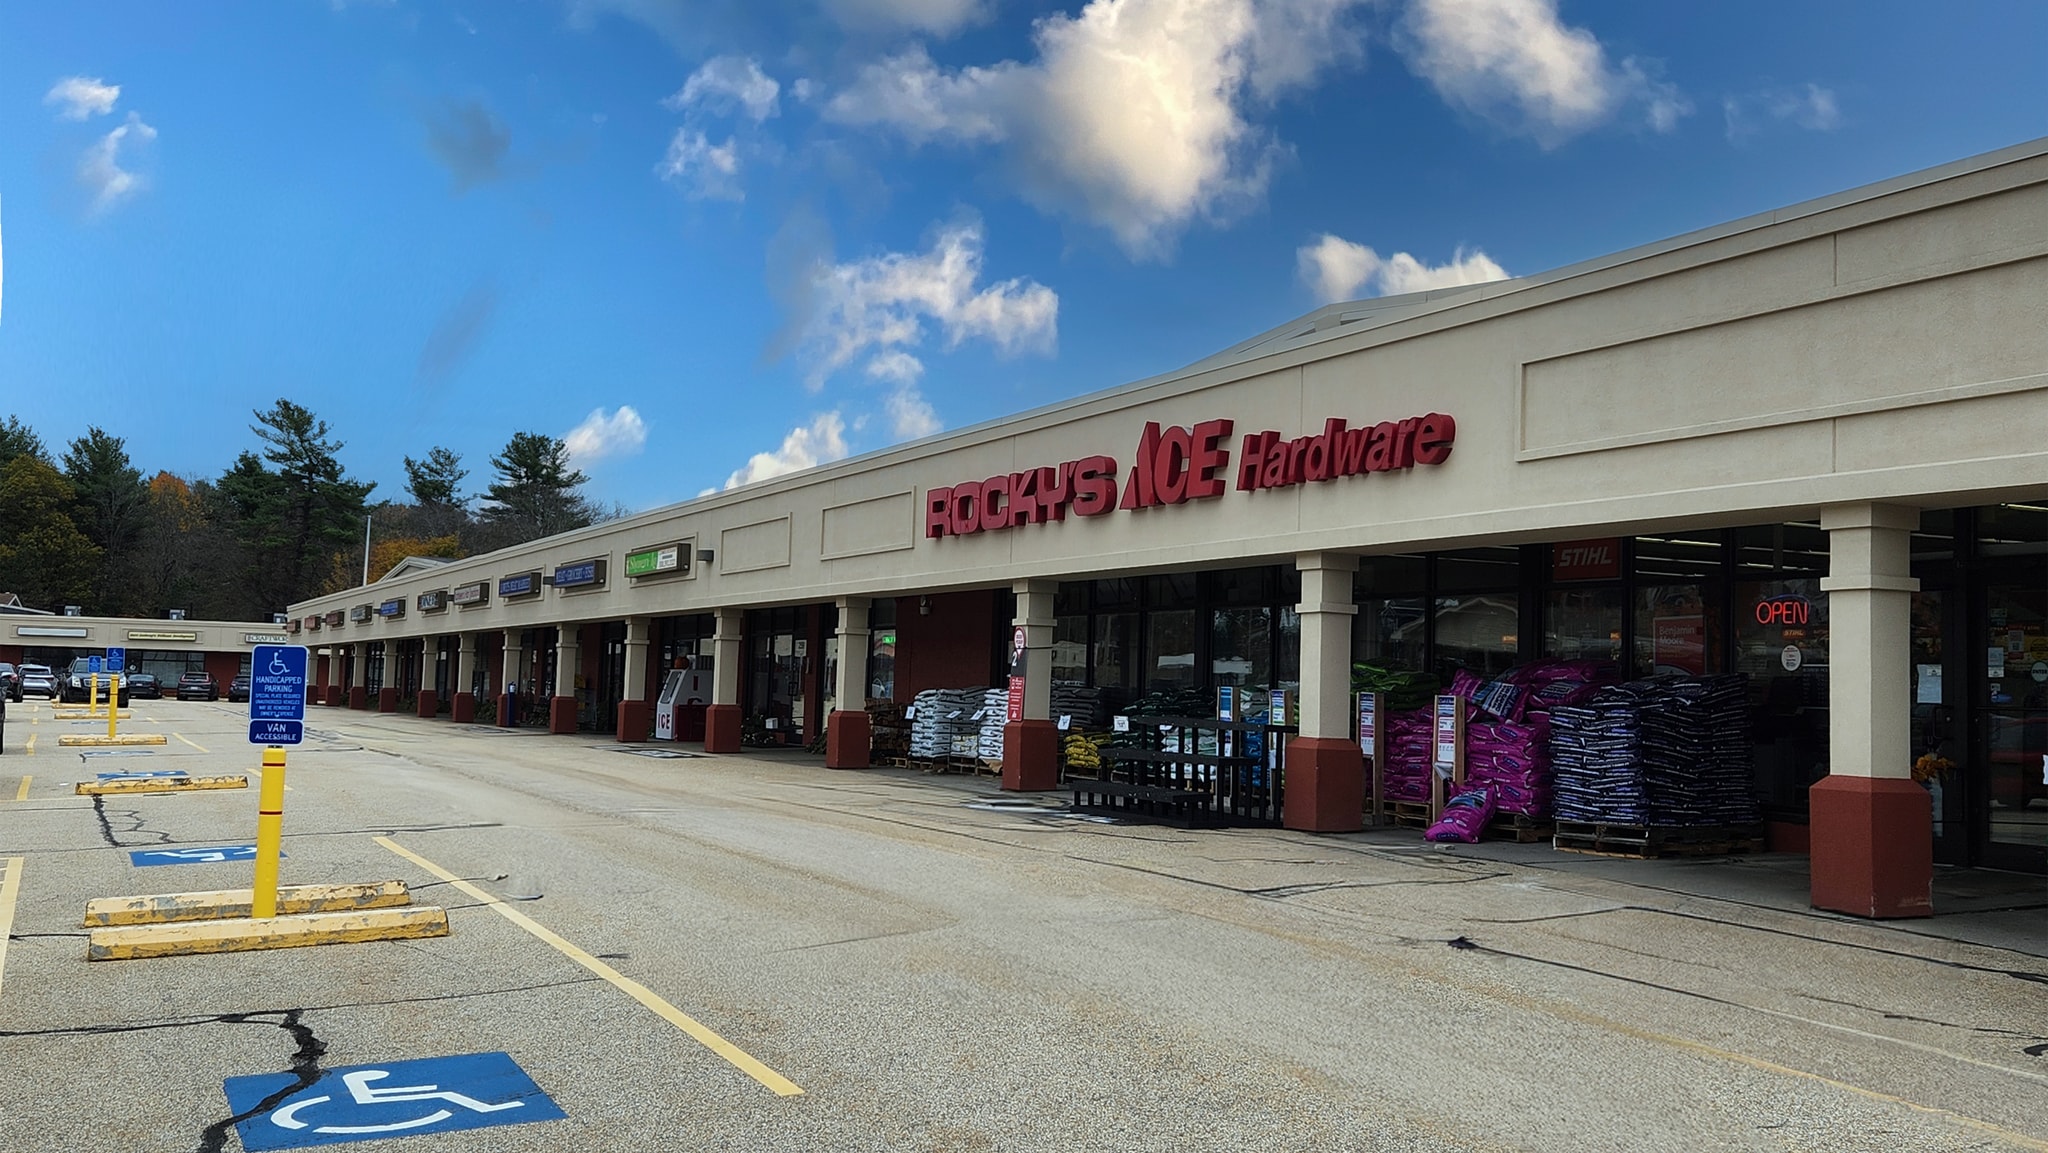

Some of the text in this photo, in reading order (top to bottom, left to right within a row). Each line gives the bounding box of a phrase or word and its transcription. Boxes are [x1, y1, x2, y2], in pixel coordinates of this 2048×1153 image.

[926, 412, 1457, 539] ROCKY'S ACE Hardware
[1559, 546, 1613, 567] STIHL
[1756, 602, 1808, 624] OPEN
[1659, 625, 1695, 637] Benjamin
[255, 676, 302, 684] HANDICAPPED
[267, 723, 287, 732] VAN
[658, 713, 671, 729] ICE
[254, 733, 297, 741] ACCESSIBLE
